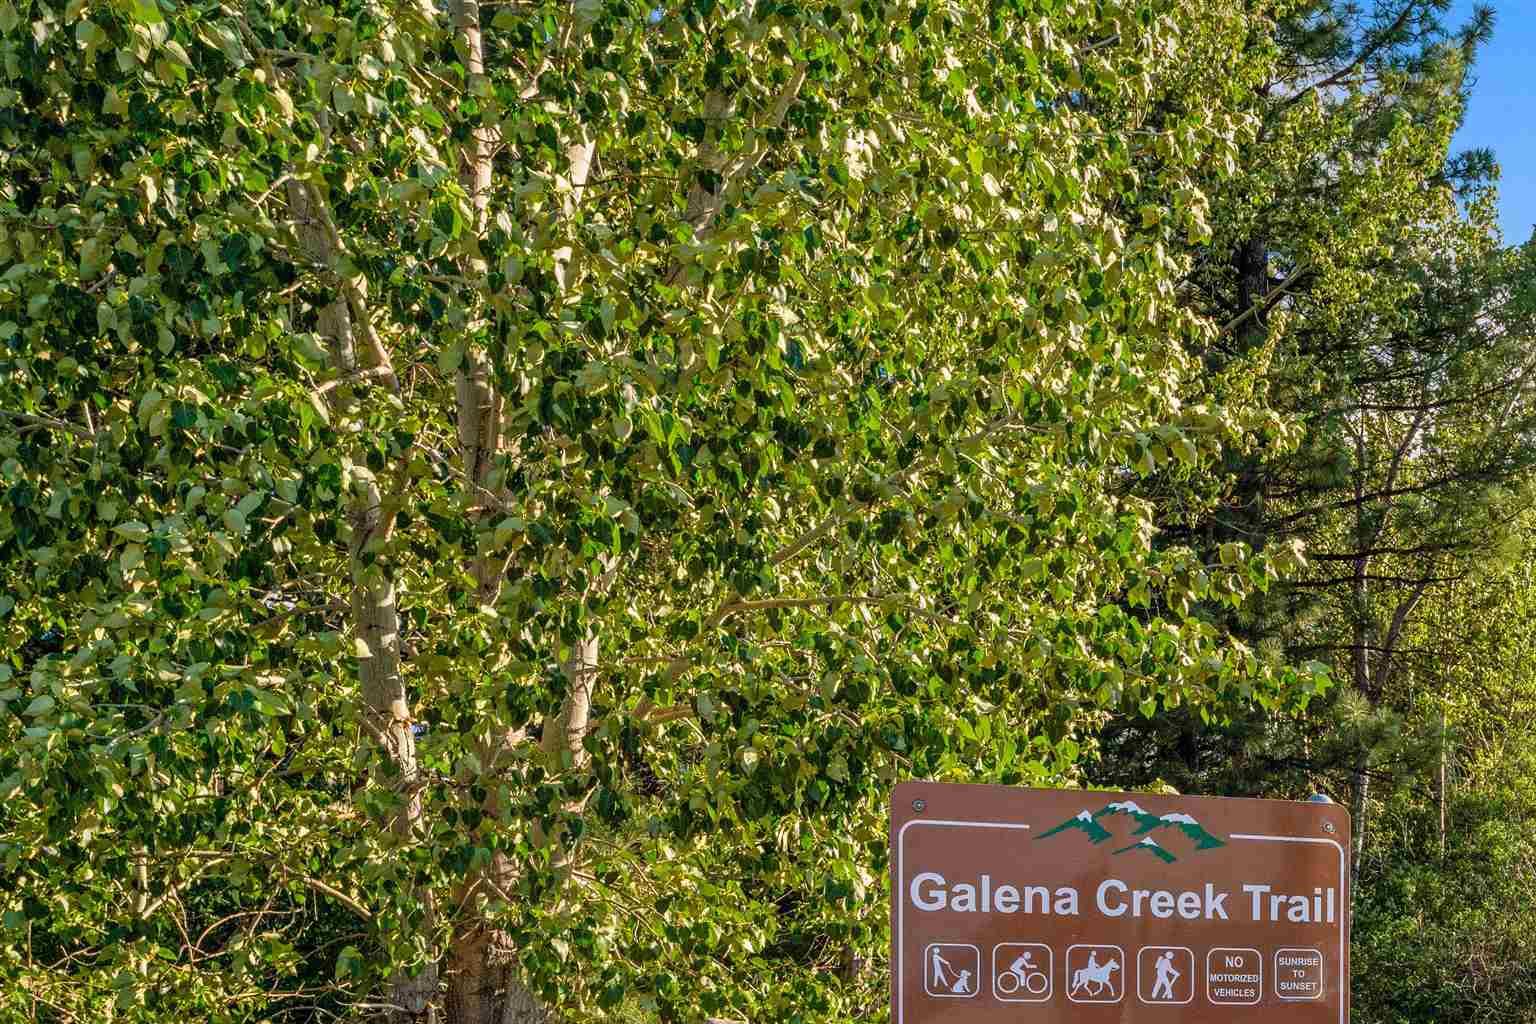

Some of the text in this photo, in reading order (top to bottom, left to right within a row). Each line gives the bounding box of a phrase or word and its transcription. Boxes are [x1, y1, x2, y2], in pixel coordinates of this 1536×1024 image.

[909, 871, 1335, 924] Galena Creek Trail
[1225, 956, 1244, 968] NO
[1278, 956, 1319, 966] SUNRISE
[1209, 973, 1258, 983] MOTORIZED
[1292, 969, 1305, 978] TO
[1279, 981, 1317, 991] SUNSET
[1214, 988, 1256, 998] VEHICLES
